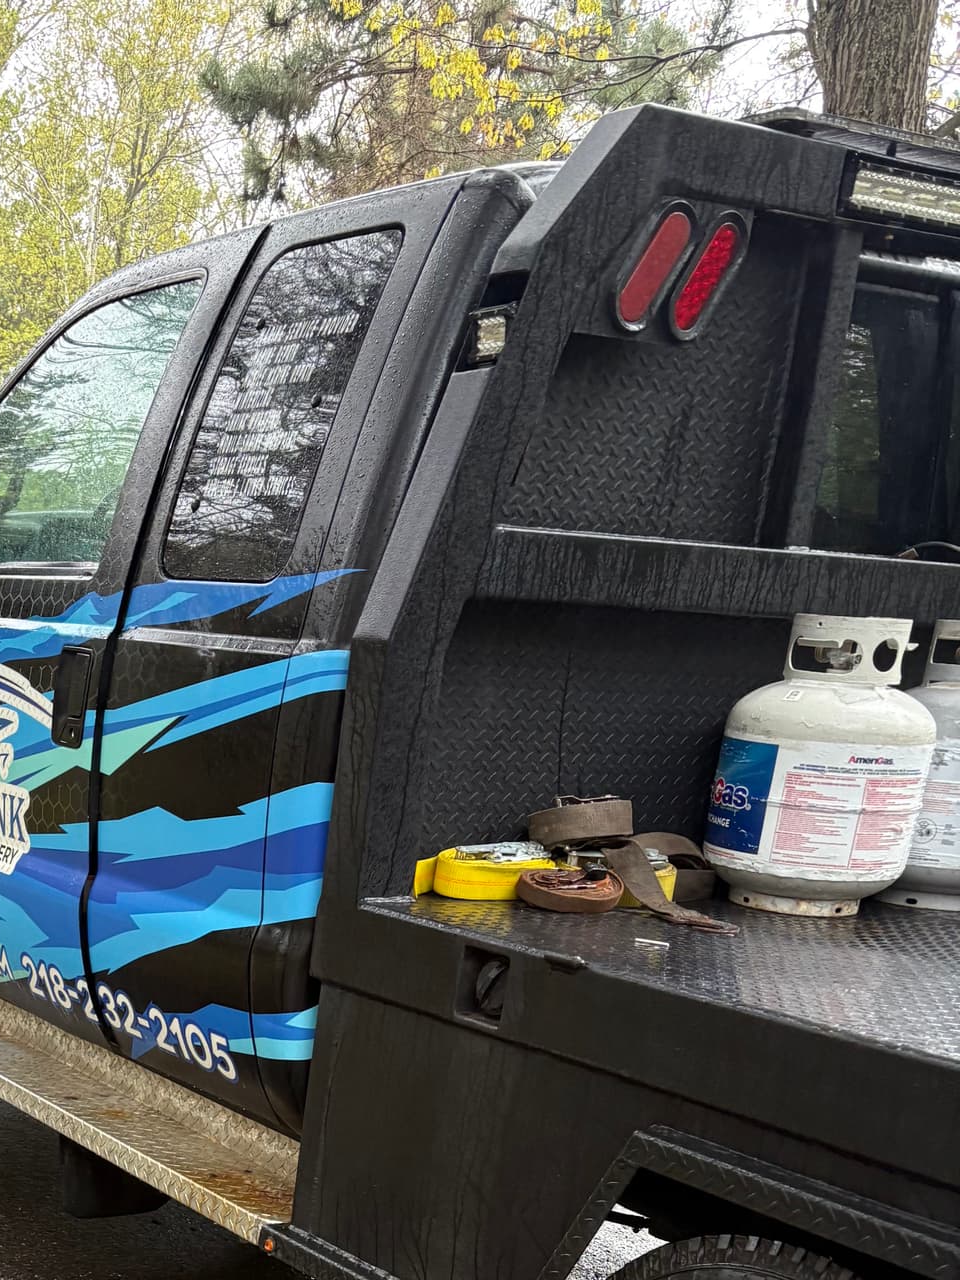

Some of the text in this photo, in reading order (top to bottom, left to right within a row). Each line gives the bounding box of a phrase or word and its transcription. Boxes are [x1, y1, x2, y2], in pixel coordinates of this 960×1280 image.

[317, 312, 360, 335] PROVIDER
[711, 777, 750, 810] Gas
[20, 954, 237, 1081] 218-232-2105
